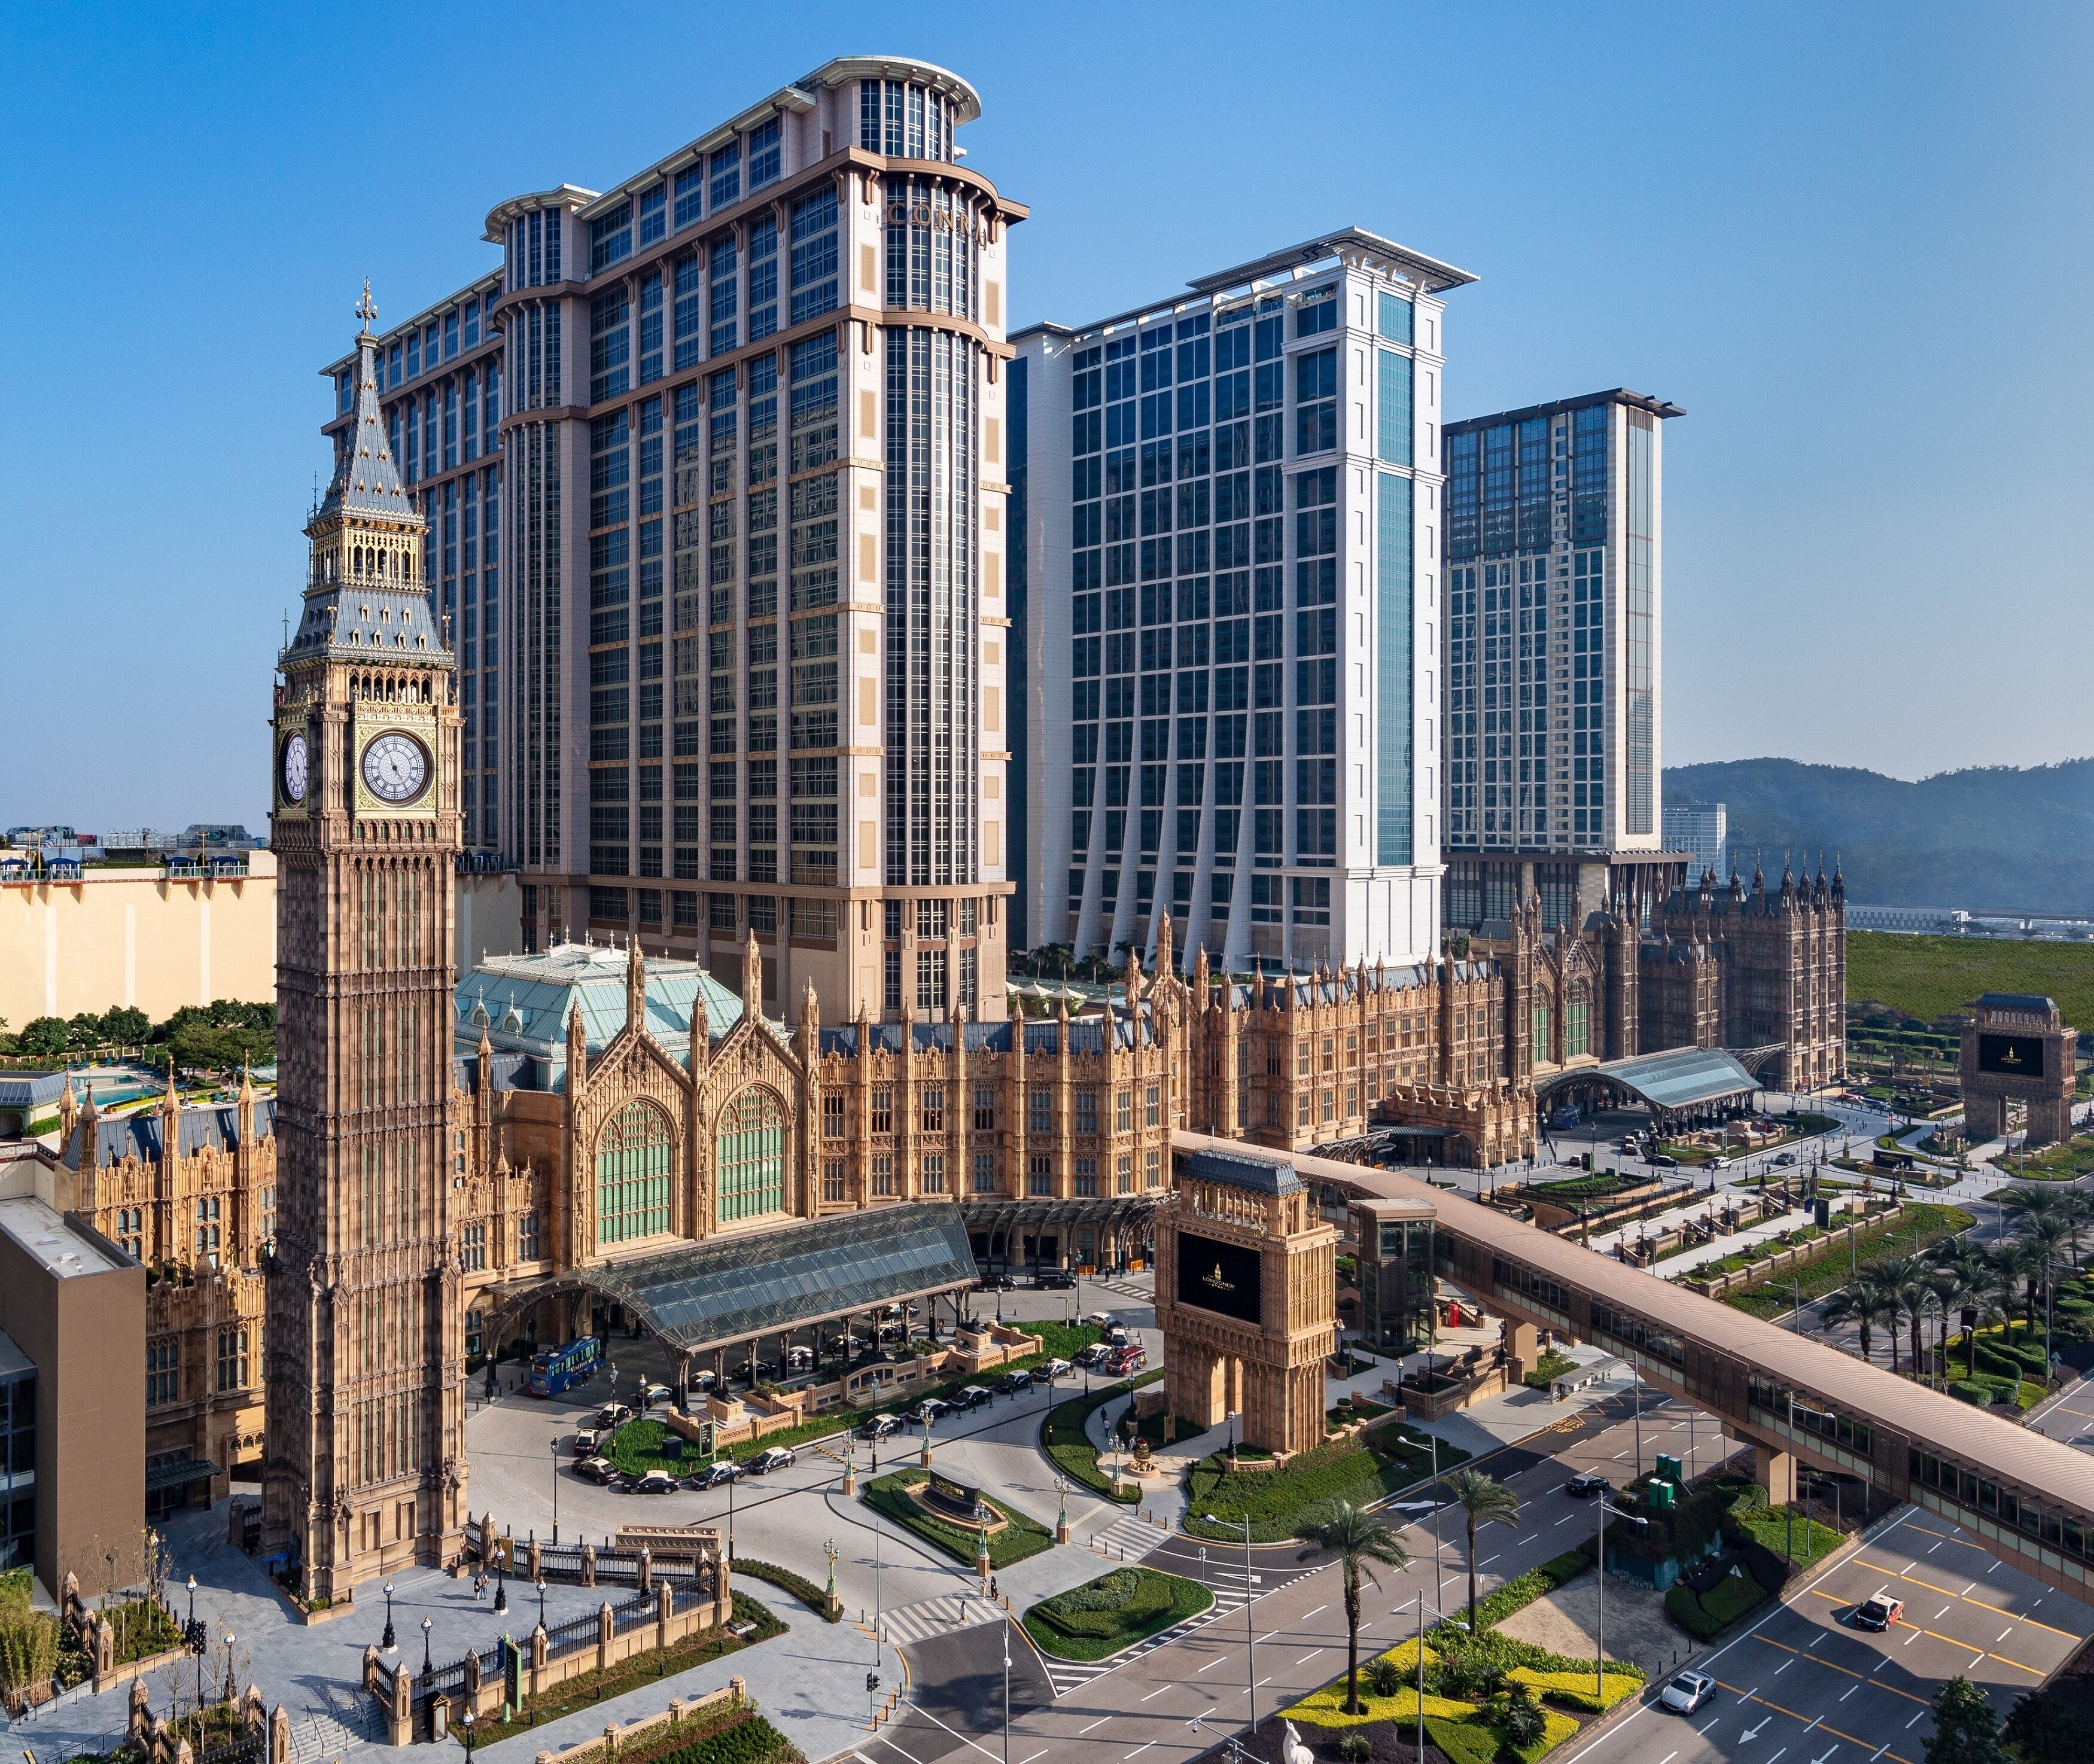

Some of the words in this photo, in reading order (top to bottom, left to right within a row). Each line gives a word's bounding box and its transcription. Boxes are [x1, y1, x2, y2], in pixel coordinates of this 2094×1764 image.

[1203, 1276, 1234, 1289] LONDONER
[1556, 1419, 1583, 1428] BUS
[1546, 1424, 1573, 1433] STOP
